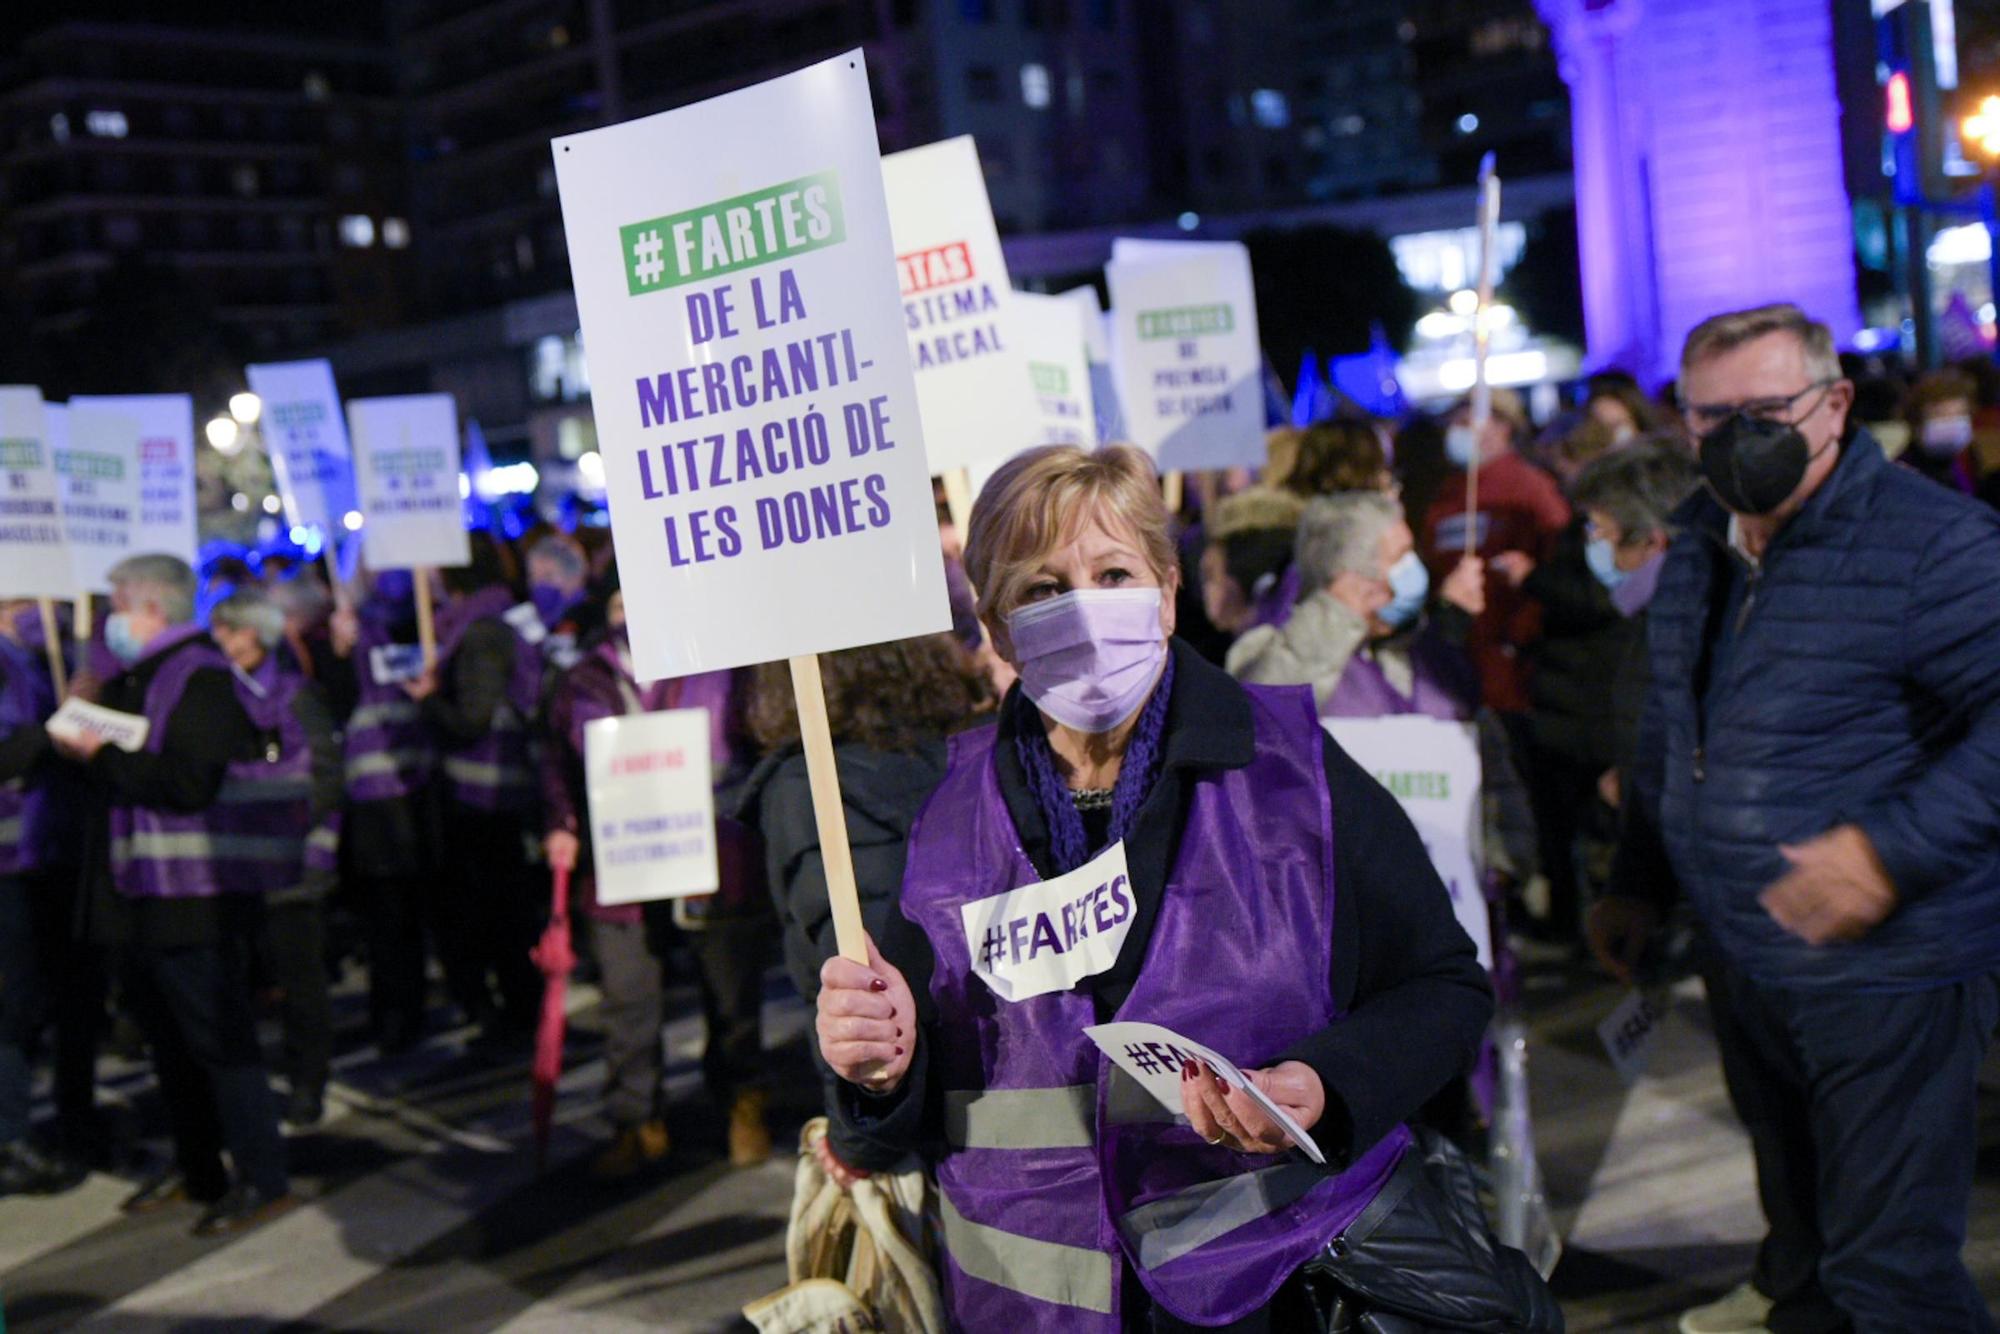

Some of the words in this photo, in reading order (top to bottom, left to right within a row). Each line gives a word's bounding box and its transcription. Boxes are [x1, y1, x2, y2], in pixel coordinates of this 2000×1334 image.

[634, 183, 832, 286] #FARTES
[686, 285, 739, 345] DE
[751, 268, 806, 331] LA
[905, 284, 998, 330] STEMA
[916, 324, 1004, 370] ARCAL
[636, 328, 874, 428] MERCANTI-
[637, 405, 830, 500] LITZACIÓ
[844, 396, 895, 458] DE
[664, 504, 742, 567] LES
[756, 473, 892, 552] DONES
[982, 874, 1130, 973] #FARTES
